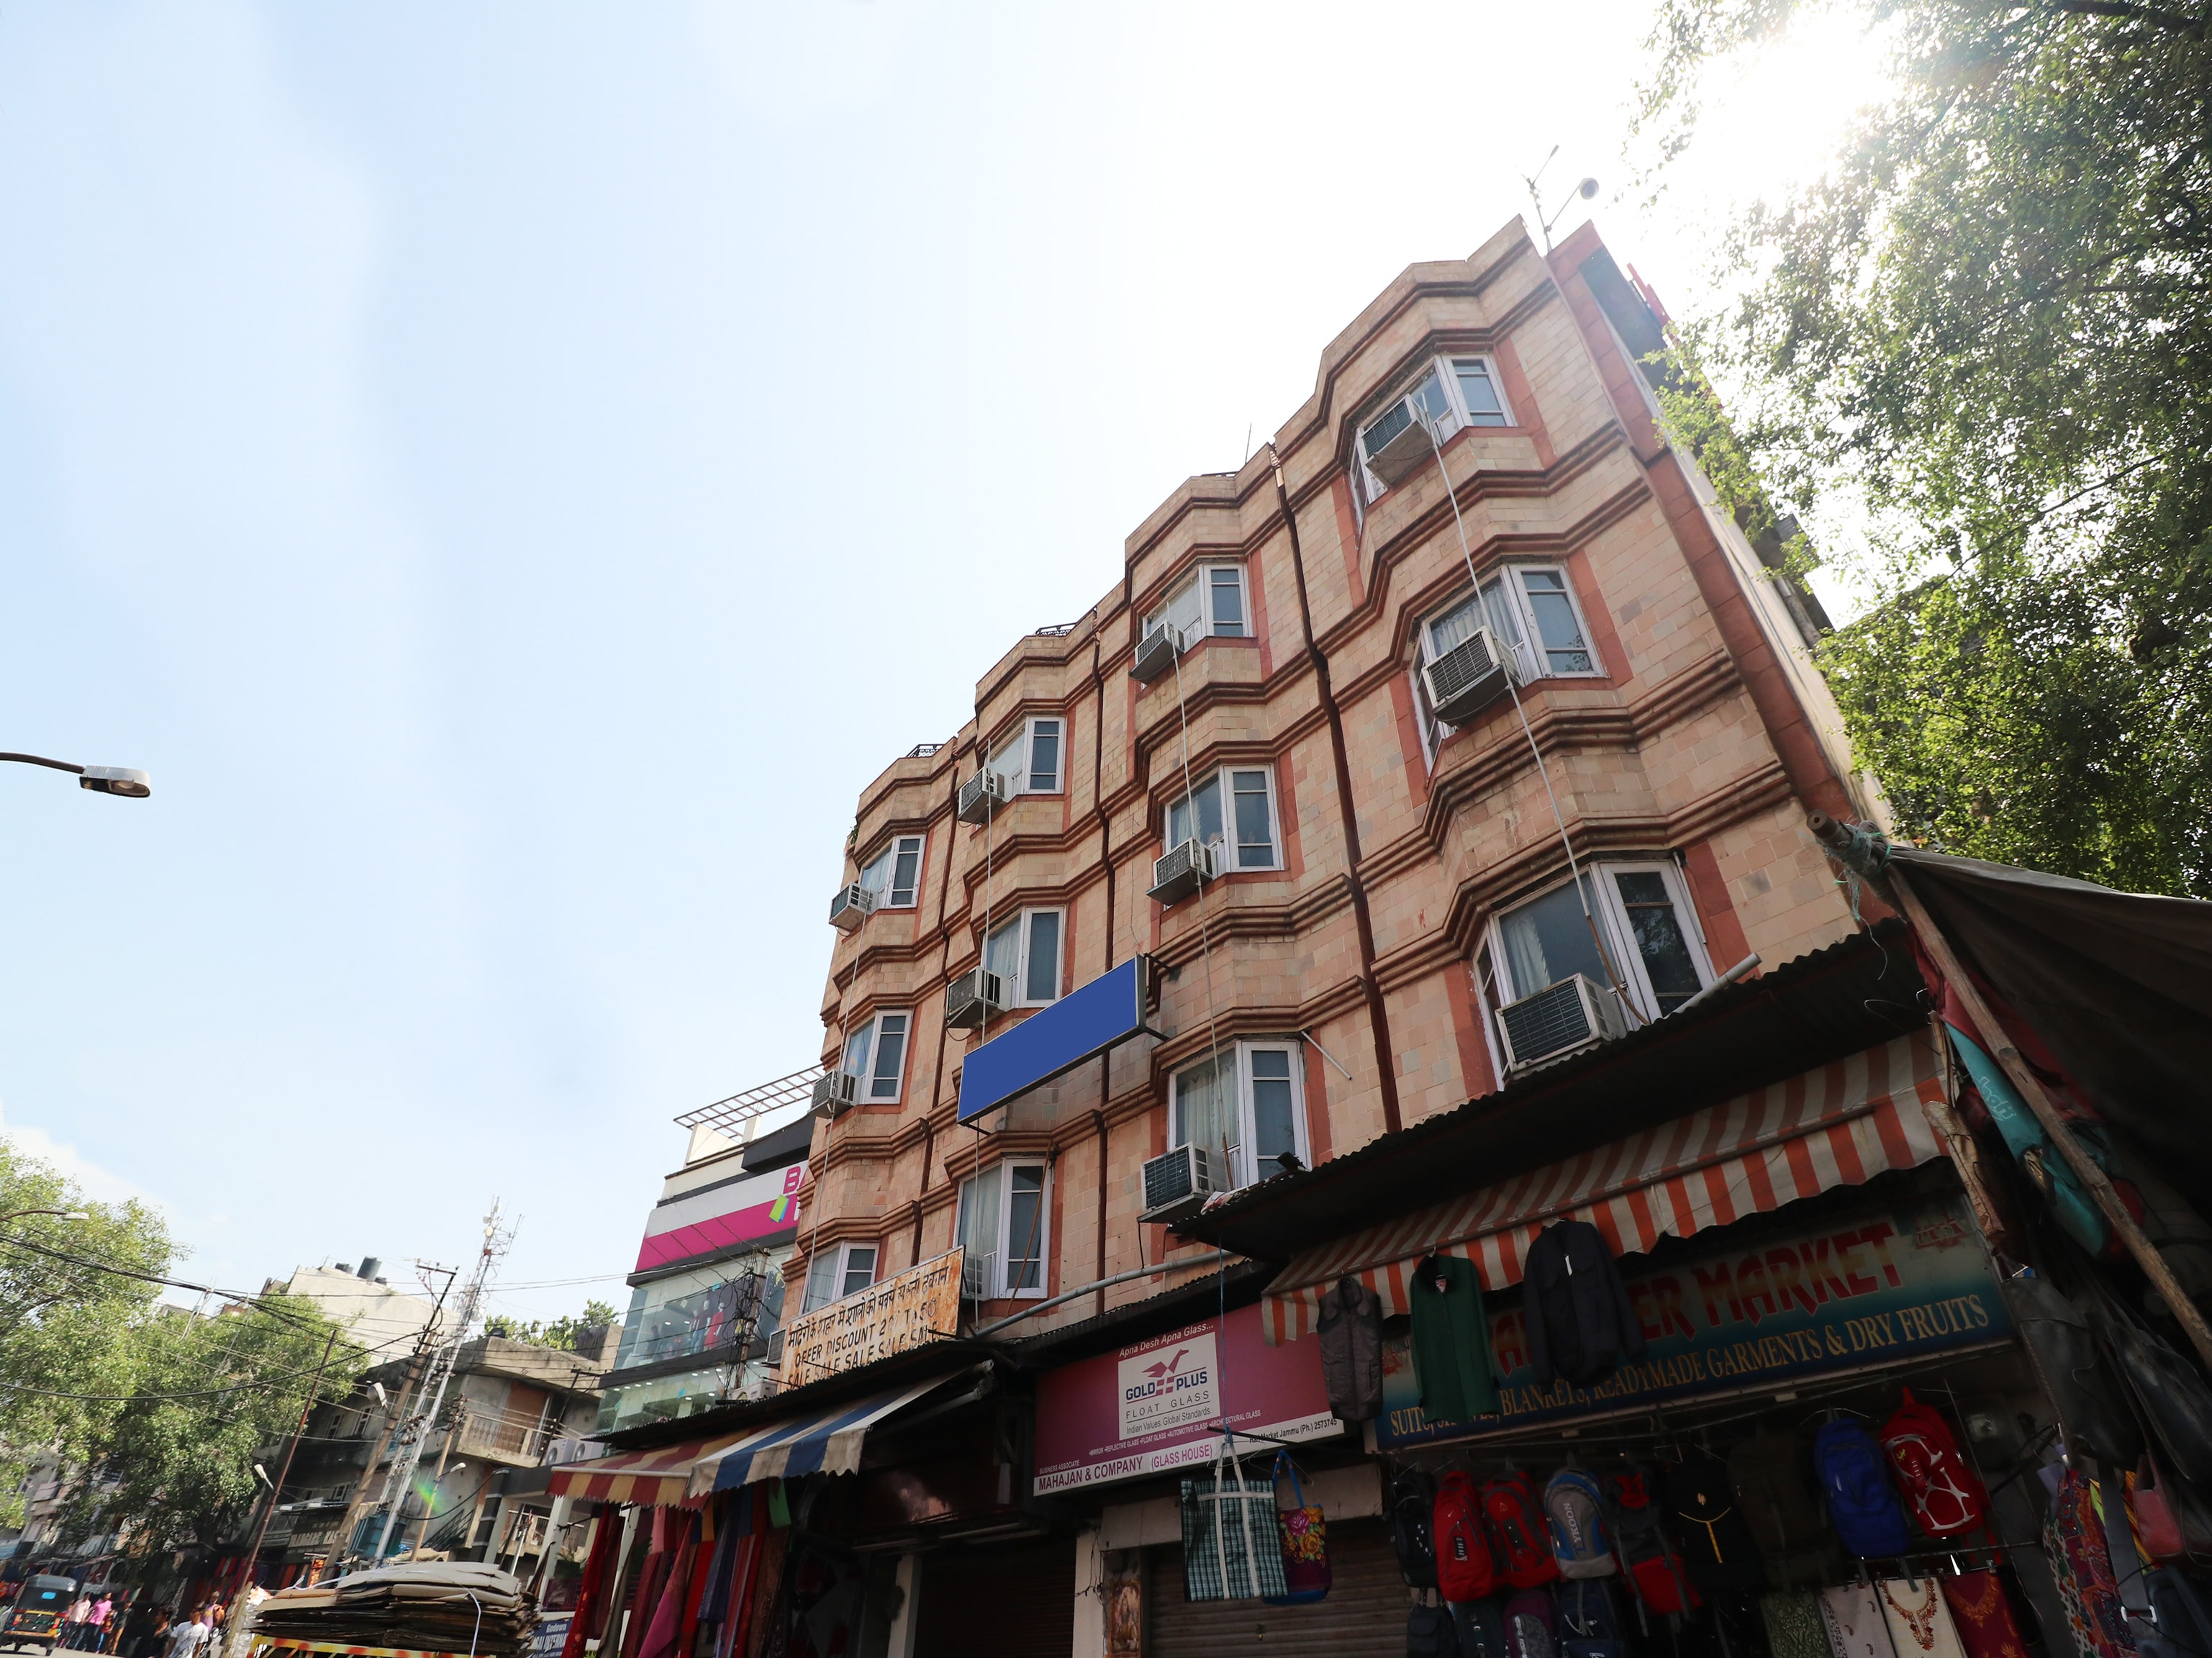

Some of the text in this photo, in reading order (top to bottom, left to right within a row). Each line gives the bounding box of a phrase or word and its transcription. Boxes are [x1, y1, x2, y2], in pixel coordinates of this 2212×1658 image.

[1695, 1221, 1904, 1328] MARKET
[795, 1344, 822, 1368] OFFER
[827, 1323, 876, 1356] DISCOUNT
[1119, 1346, 1138, 1358] Apna
[1140, 1338, 1159, 1351] Desh
[1161, 1331, 1182, 1345] Apna
[1706, 1328, 1823, 1380] GARMENTS
[1826, 1324, 1848, 1356] &
[1844, 1305, 1898, 1352] DRY
[1895, 1294, 1990, 1342] FRUITS
[845, 1345, 875, 1370] SALE
[1126, 1371, 1207, 1400] GOLD PLUS
[1126, 1390, 1210, 1419] FLOAT GLASS
[1211, 1413, 1246, 1428] ARCHIECTURAL
[1246, 1409, 1261, 1419] GLASS
[1126, 1425, 1142, 1434] Indian
[1163, 1414, 1180, 1426] Global
[1279, 1428, 1299, 1438] Jammu
[1039, 1459, 1080, 1474] BUSINESS ASSOCIATE
[1039, 1444, 1212, 1490] MAHAJAN & COMPANY (GLASS HOUSE)
